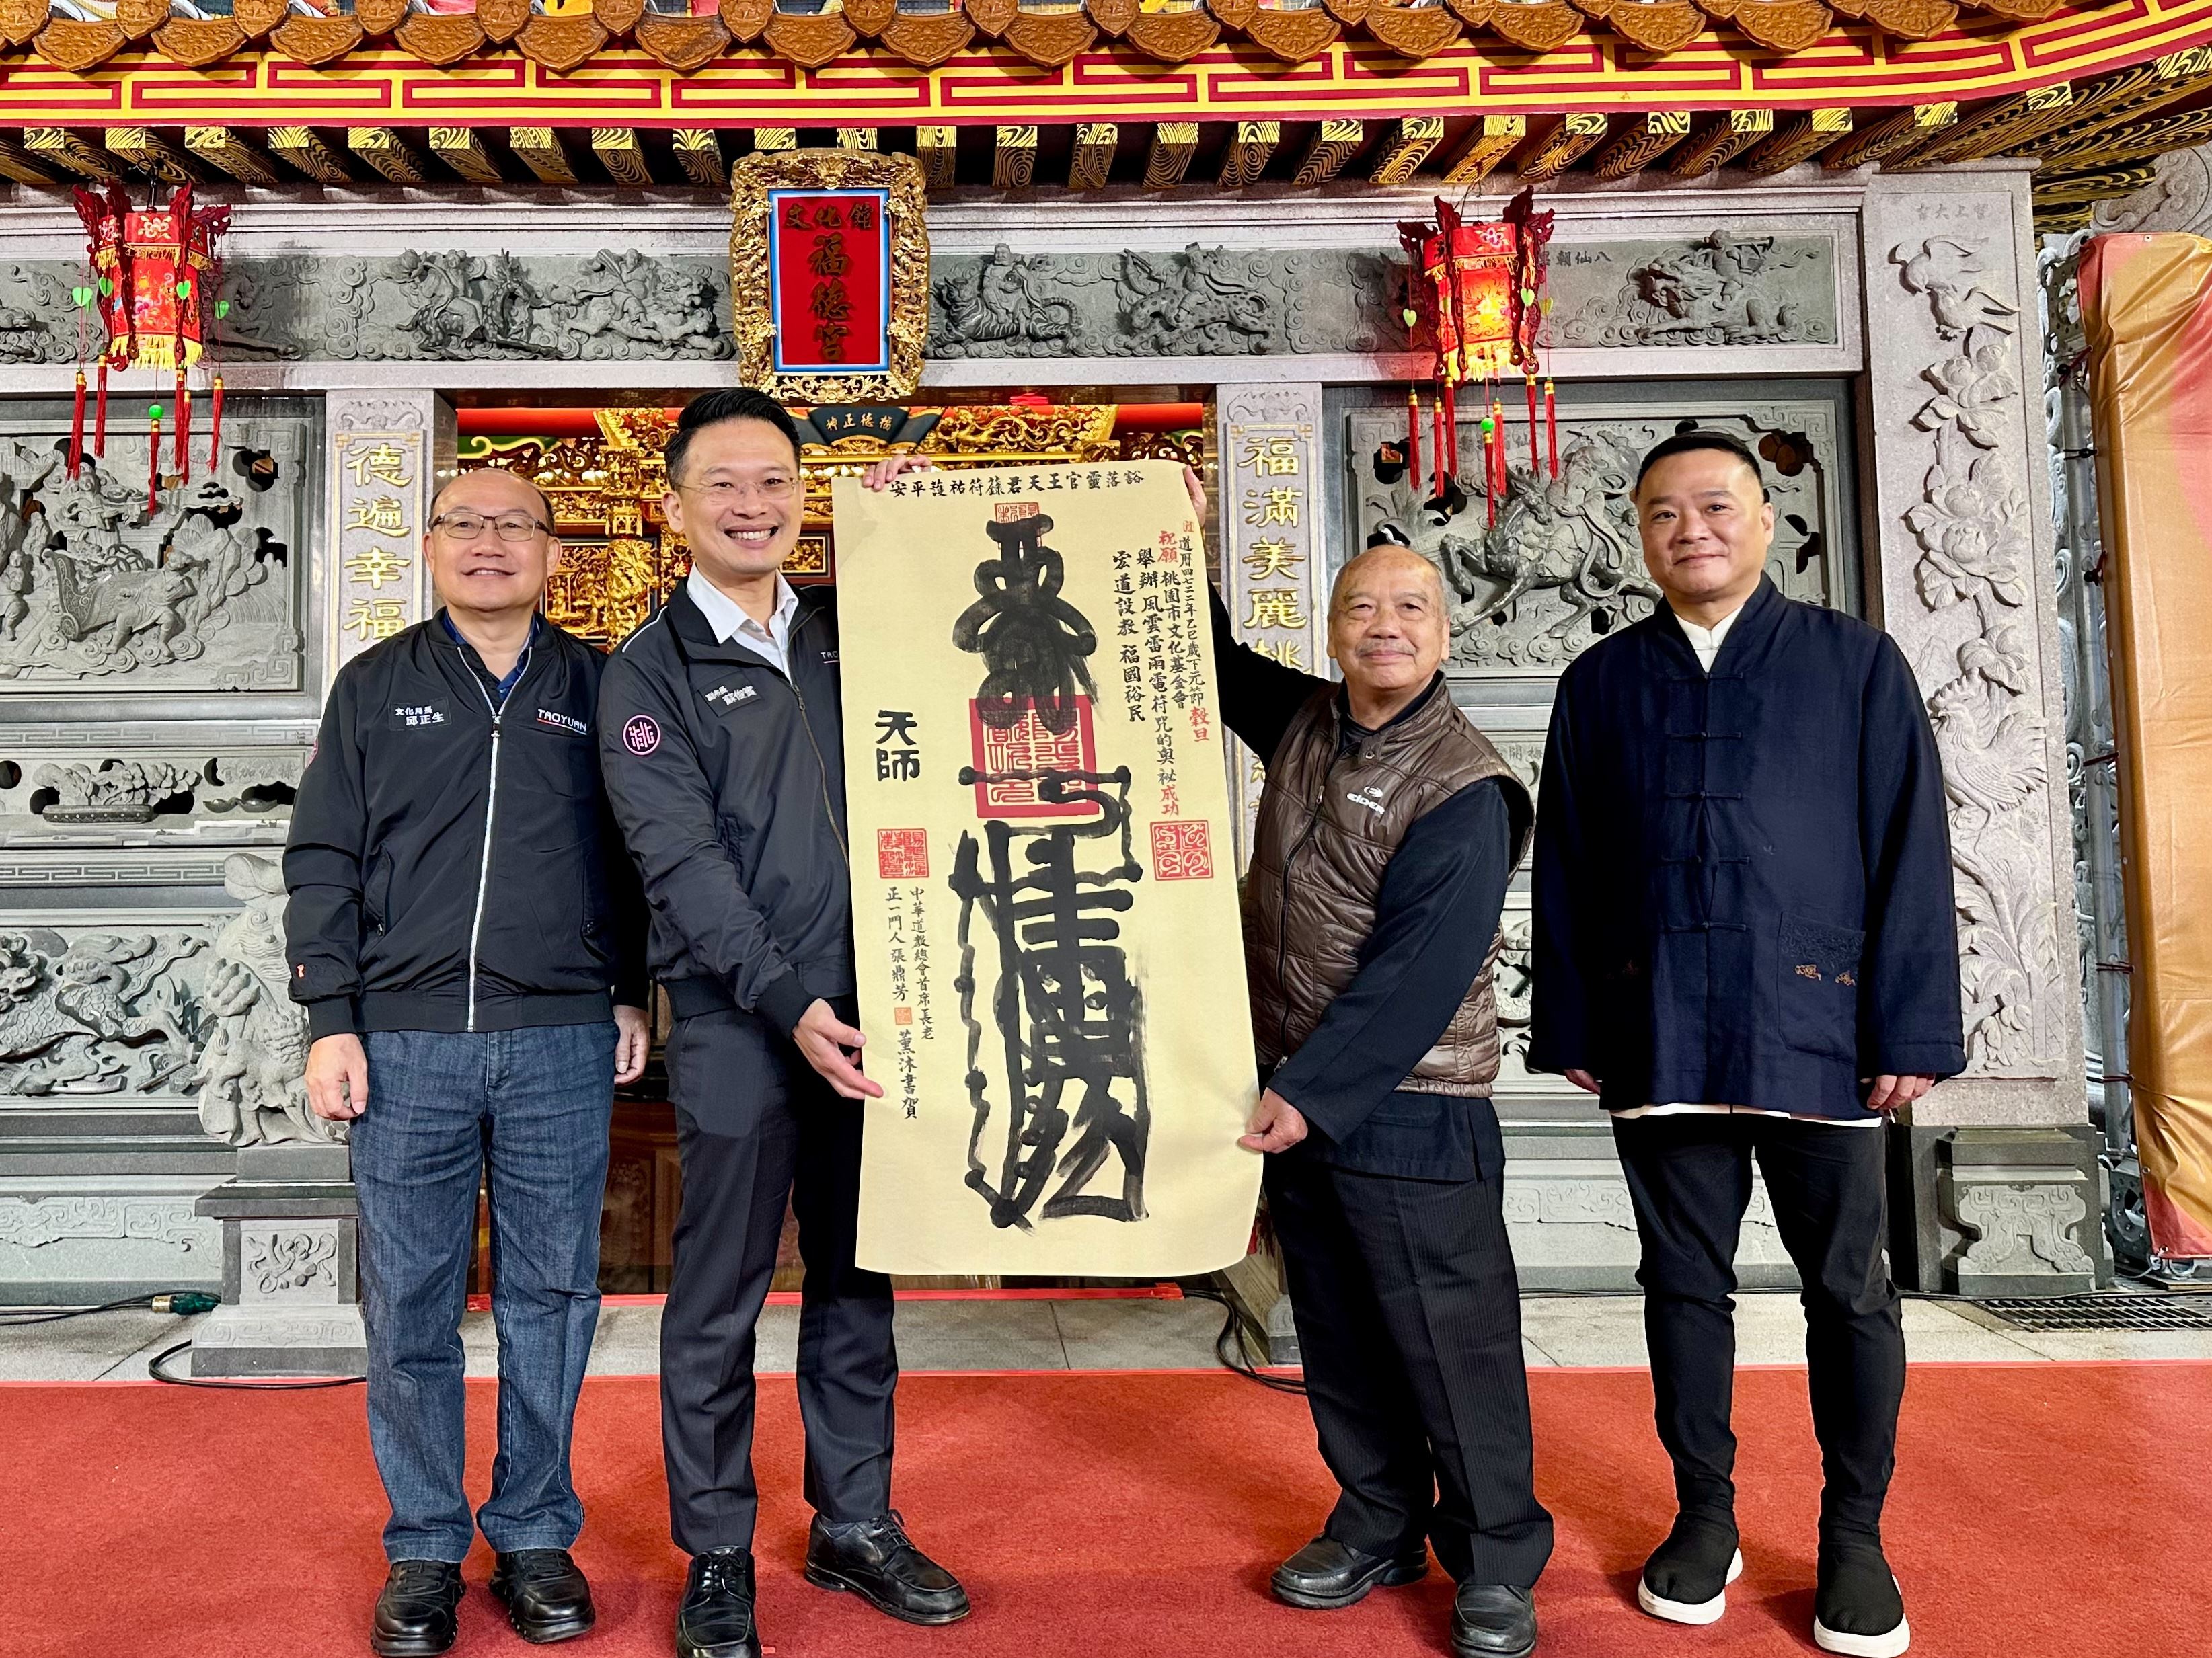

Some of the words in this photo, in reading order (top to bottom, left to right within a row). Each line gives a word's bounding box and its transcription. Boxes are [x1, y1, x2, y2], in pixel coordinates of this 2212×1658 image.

[809, 232, 851, 360] 福德宮
[344, 442, 413, 641] 德遍幸福
[1157, 530, 1179, 563] 祝願
[395, 705, 433, 716] 文化局長
[537, 709, 587, 732] TAOYUAN
[1119, 645, 1146, 723] 福國裕民
[875, 709, 921, 782] 天師
